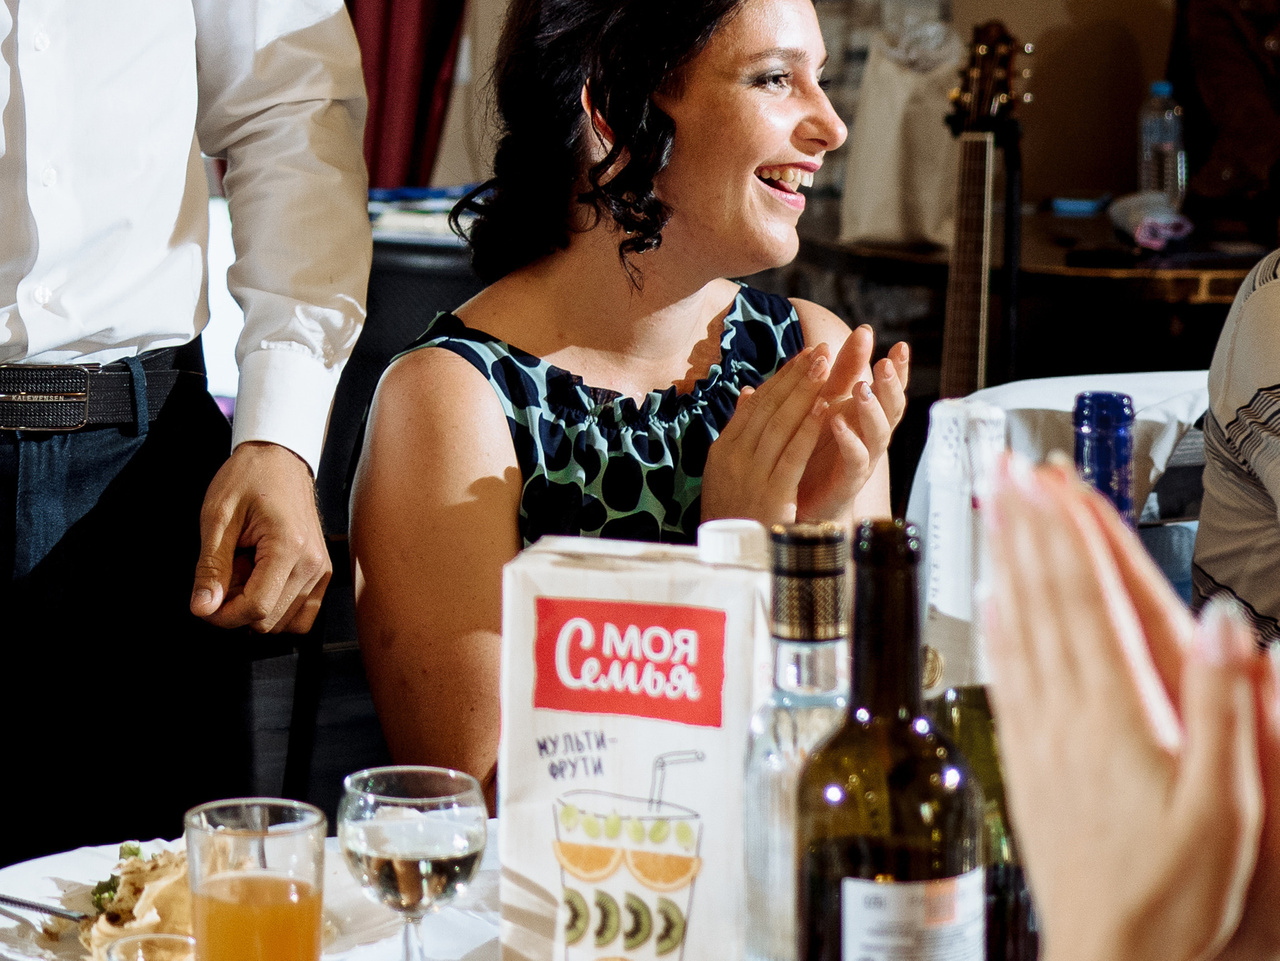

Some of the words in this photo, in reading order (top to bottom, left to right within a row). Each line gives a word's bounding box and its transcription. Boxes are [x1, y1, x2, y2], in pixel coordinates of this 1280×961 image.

[555, 617, 701, 701] Семья
[602, 622, 697, 666] МОЯ
[548, 758, 605, 779] ФРУТИ
